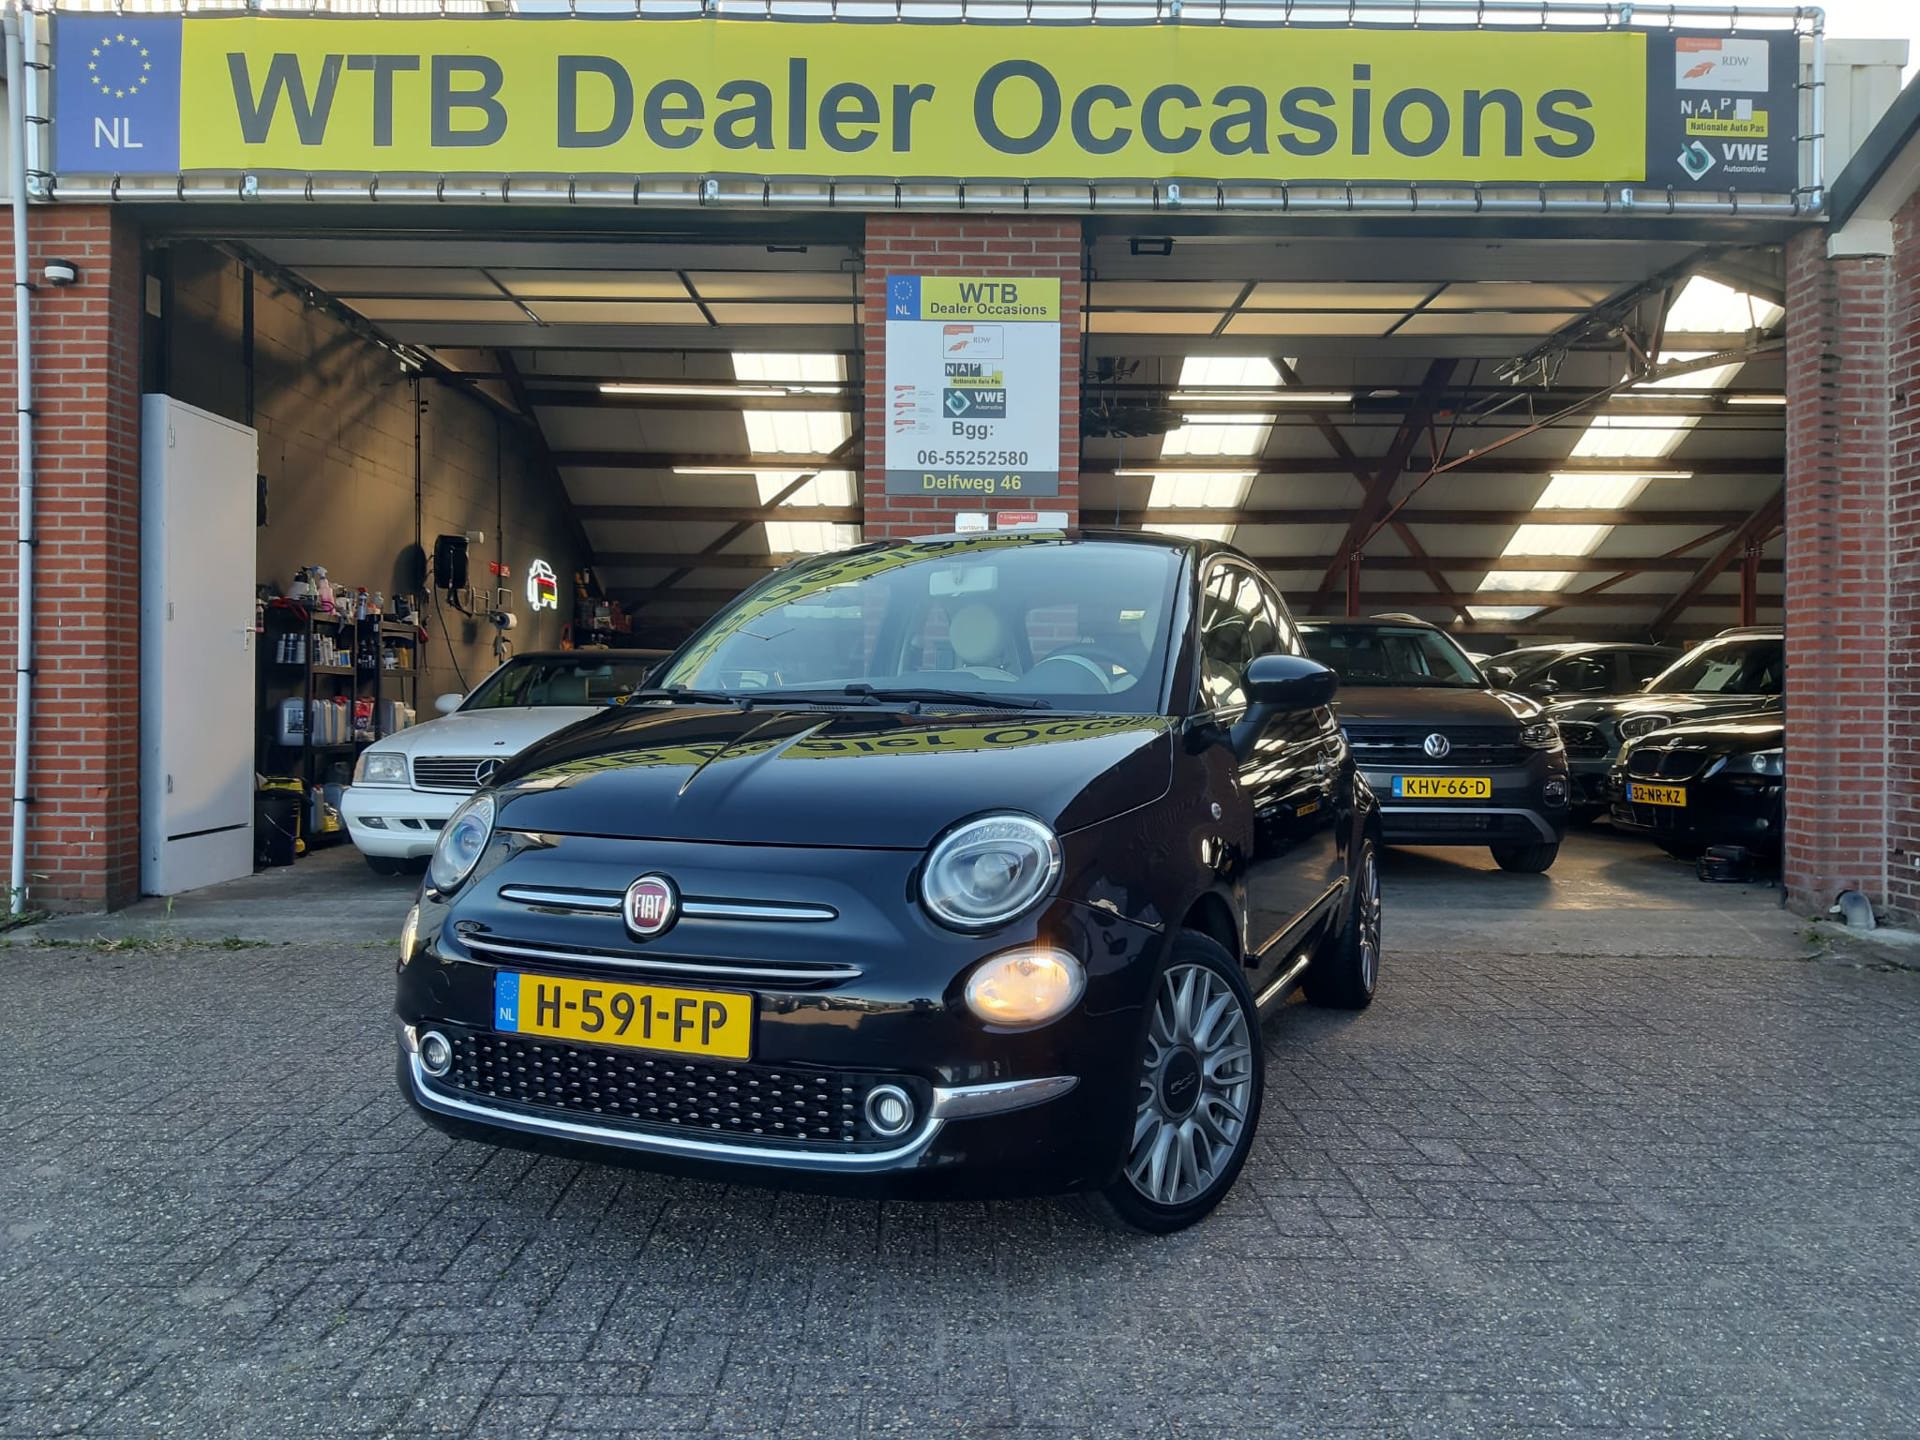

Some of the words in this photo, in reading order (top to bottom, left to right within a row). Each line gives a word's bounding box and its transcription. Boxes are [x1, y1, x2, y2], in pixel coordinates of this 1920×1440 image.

[1721, 56, 1749, 67] RDW
[226, 52, 509, 148] WTB
[557, 54, 936, 153] Dealer
[973, 59, 1596, 159] Occasions
[94, 117, 143, 149] NL
[1690, 122, 1728, 132] Nationale
[1730, 123, 1748, 132] Auto
[1750, 124, 1765, 133] Pas
[1722, 143, 1769, 162] VWE
[1723, 164, 1767, 174] Automotive
[959, 282, 1018, 304] WTB
[895, 304, 911, 315] NL
[930, 302, 974, 315] Dealer
[976, 303, 1047, 316] Occasions
[973, 336, 991, 345] RDW
[974, 391, 1005, 403] VWE
[952, 421, 994, 440] Bgg:
[917, 450, 1028, 466] 06-55252580
[923, 474, 995, 493] Delfweg
[1000, 475, 1022, 490] 46
[1406, 778, 1486, 795] KHV-66-D
[1632, 786, 1680, 804] 32-NR-KZ
[634, 893, 662, 920] FIAT
[500, 1006, 515, 1022] NL
[536, 983, 728, 1045] H-591-FP
